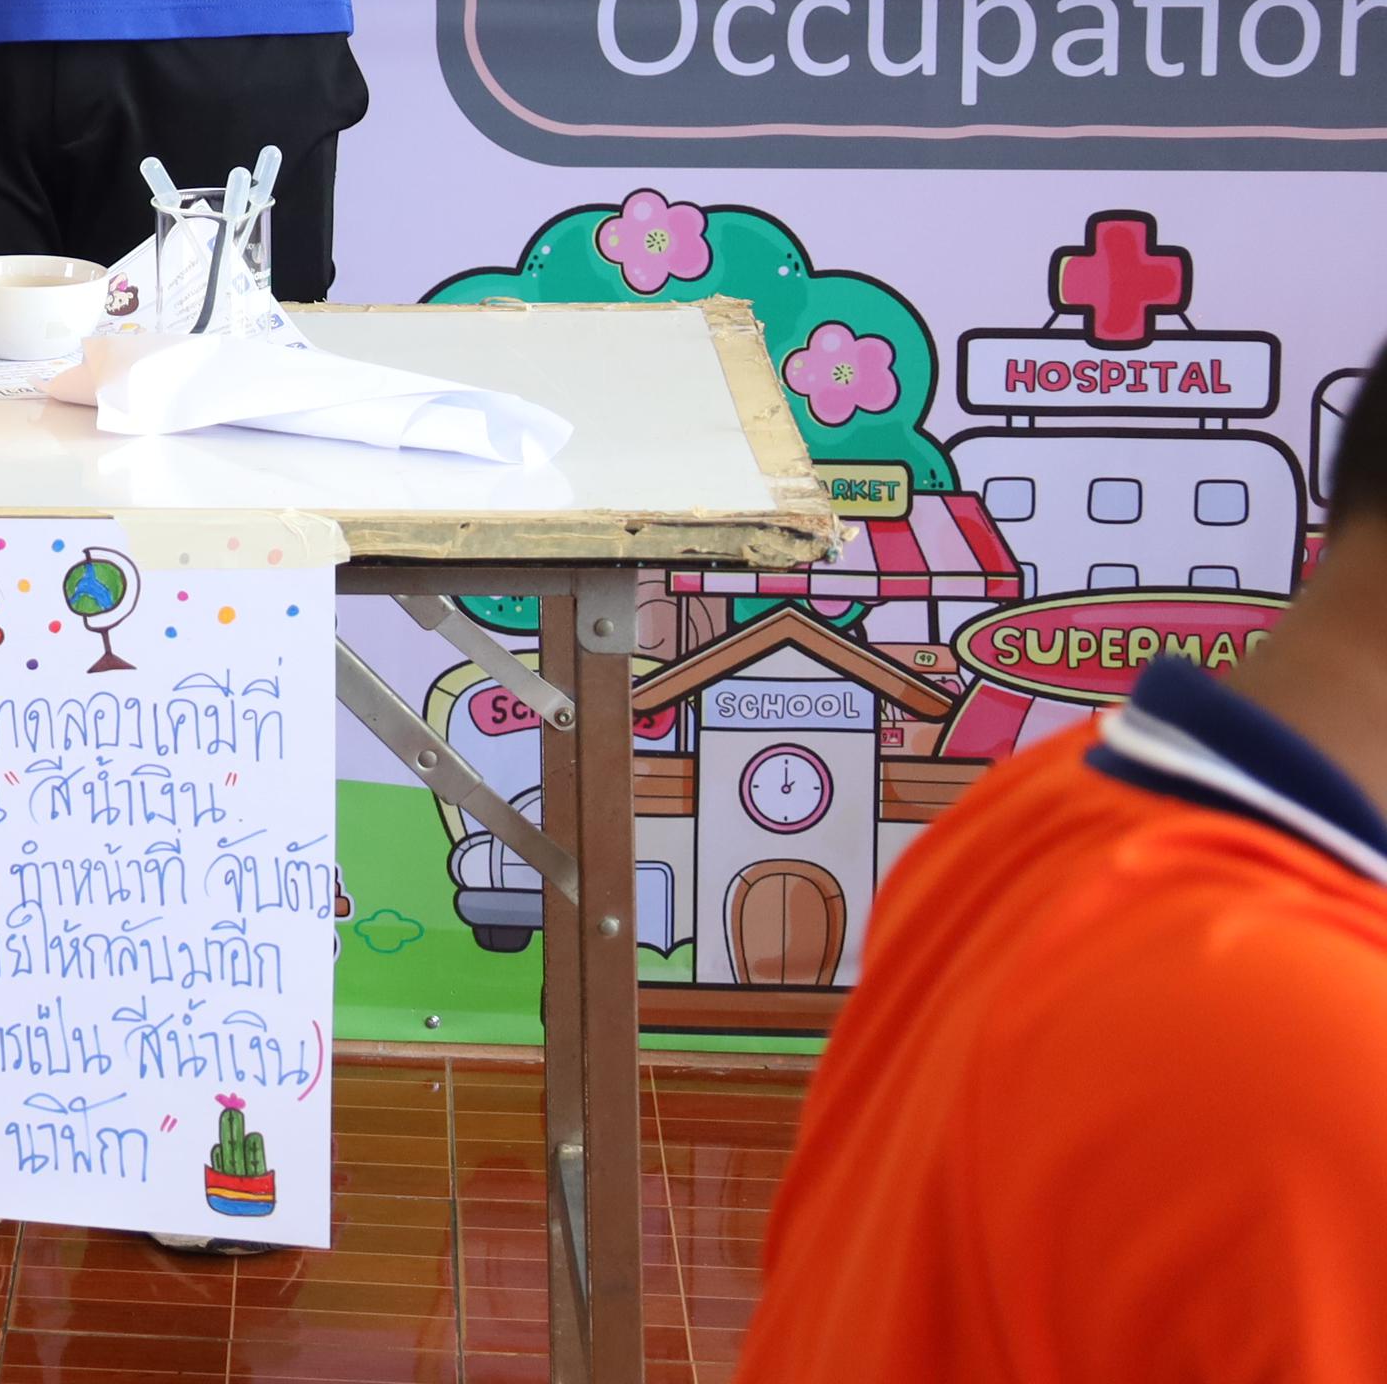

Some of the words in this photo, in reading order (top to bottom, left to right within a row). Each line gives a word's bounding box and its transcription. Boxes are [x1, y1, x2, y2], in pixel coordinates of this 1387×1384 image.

[1005, 357, 1232, 395] HOSPITAL
[823, 477, 901, 502] RKET
[714, 689, 860, 722] SCHOOL
